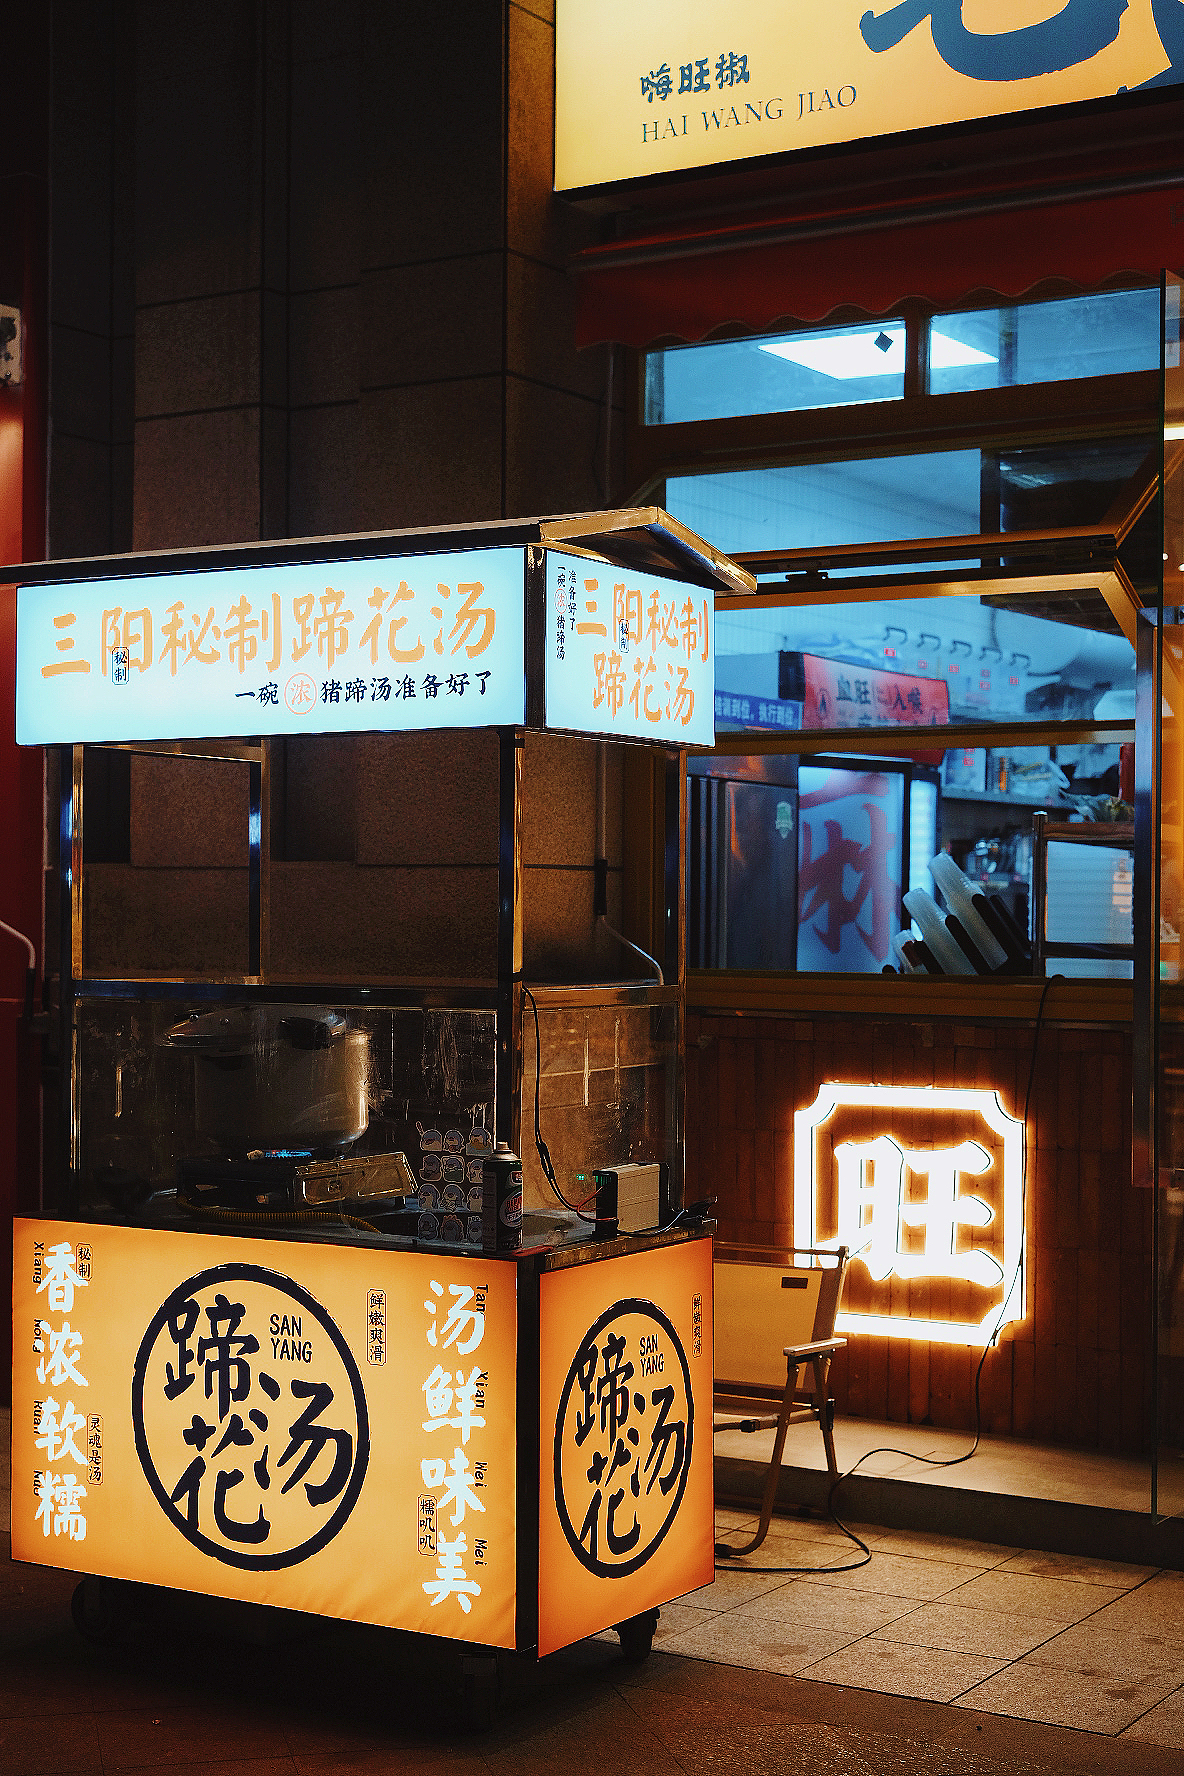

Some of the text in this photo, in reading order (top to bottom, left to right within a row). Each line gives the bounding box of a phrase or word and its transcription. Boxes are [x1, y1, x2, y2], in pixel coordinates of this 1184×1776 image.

[640, 51, 750, 104] 嗨旺椒
[641, 84, 858, 144] HAI WANG JIAO
[41, 580, 497, 679] 三阳秘制蹄花汤
[576, 578, 709, 664] 三阳秘制
[113, 650, 128, 683] 秘制
[592, 649, 695, 727] 蹄花汤
[816, 1134, 1005, 1288] 旺
[33, 1241, 45, 1285] Xiang
[78, 1247, 91, 1279] 秘制
[269, 1313, 302, 1338] SAN
[369, 1293, 384, 1362] 鲜嫩爽滑
[475, 1284, 489, 1320] Tan
[270, 1337, 312, 1363] YANG
[639, 1333, 659, 1357] SAN
[640, 1354, 665, 1379] YANG
[35, 1241, 89, 1542] 香浓软糯
[88, 1416, 102, 1481] 灵魂是汤
[421, 1280, 487, 1614] 汤鲜味美
[475, 1461, 488, 1488] Wei
[419, 1499, 435, 1551] 糯叽叽
[475, 1538, 488, 1566] Mei
